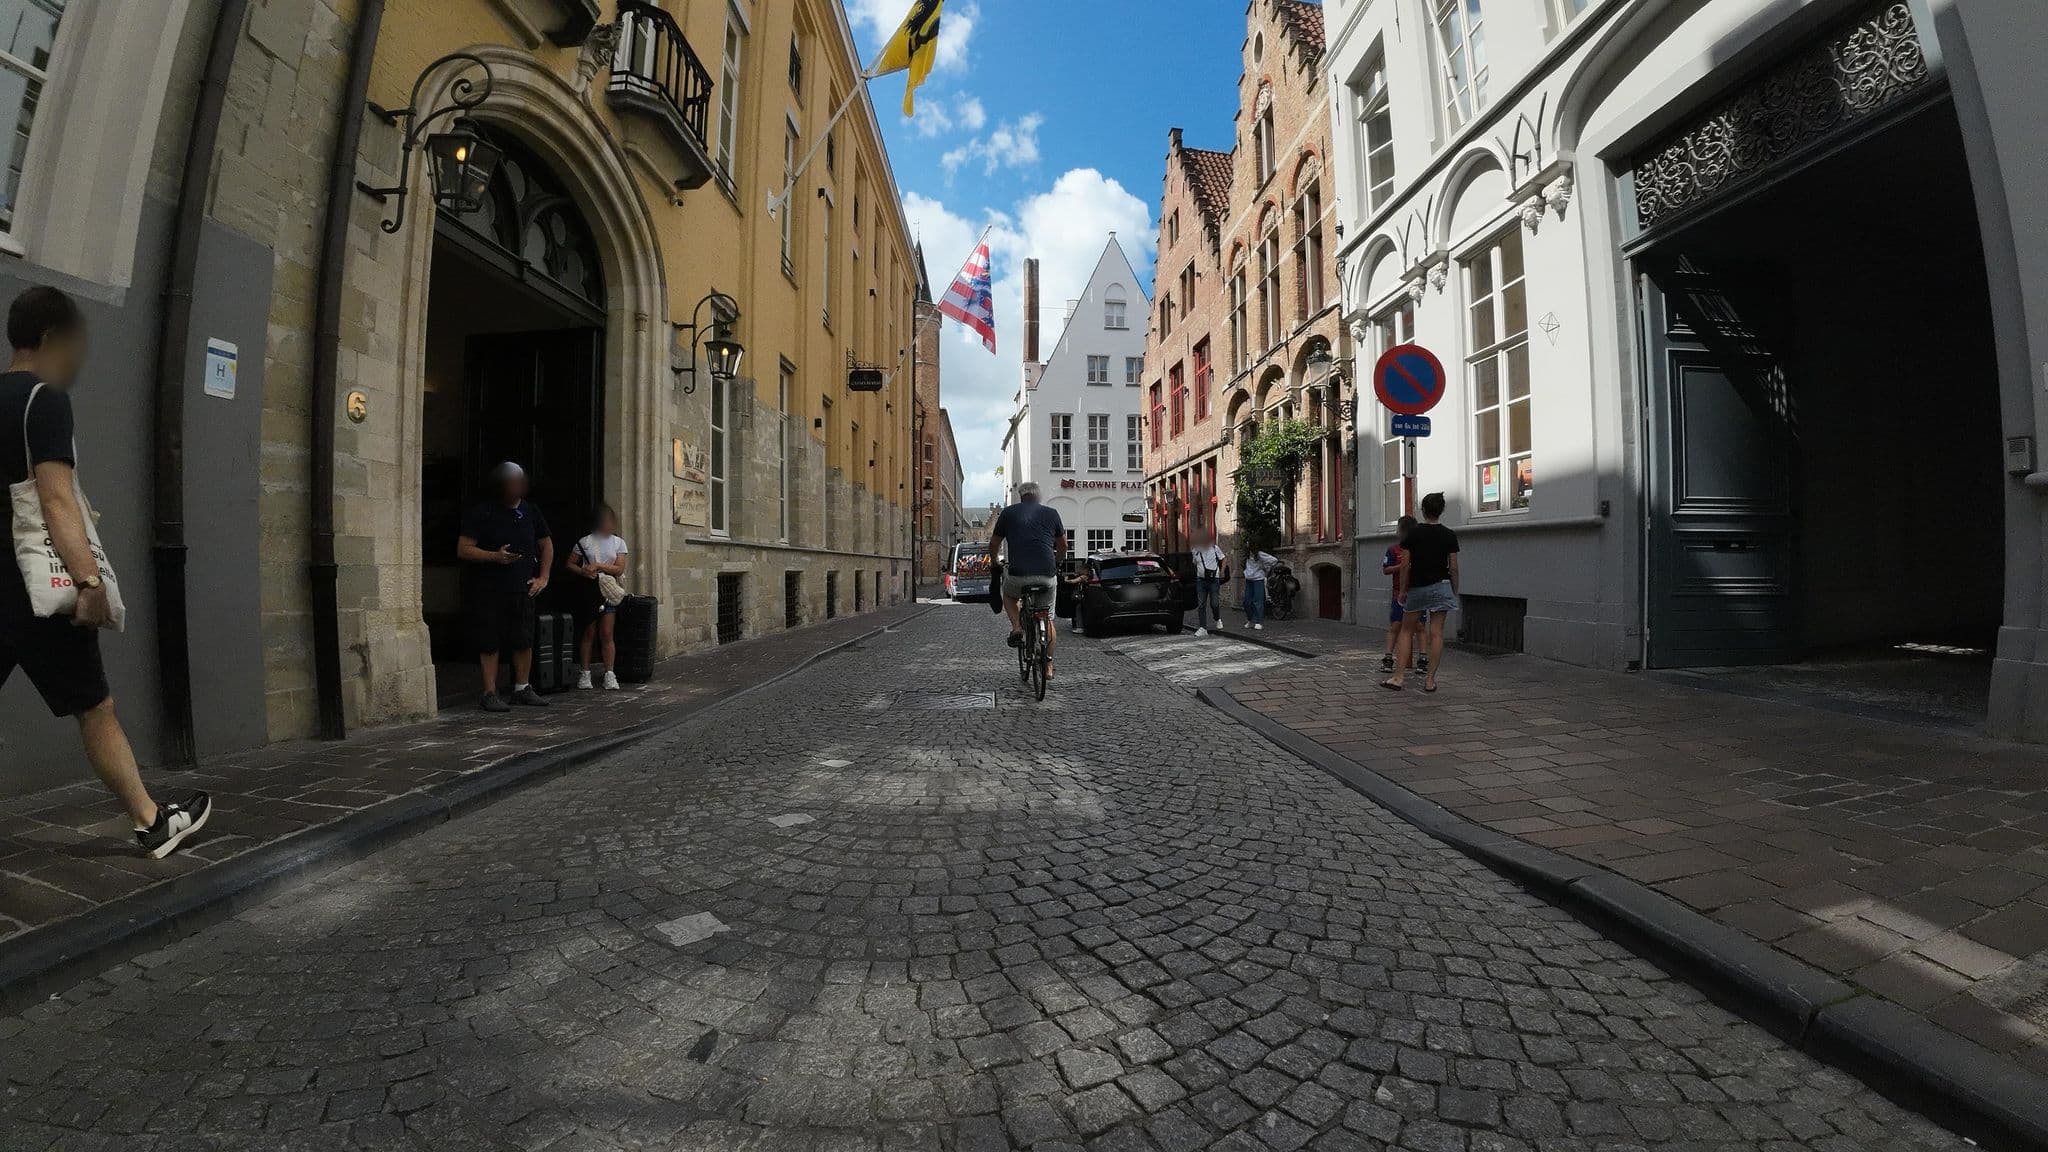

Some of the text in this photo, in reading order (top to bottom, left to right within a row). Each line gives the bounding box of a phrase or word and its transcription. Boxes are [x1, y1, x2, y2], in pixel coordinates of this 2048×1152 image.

[216, 362, 226, 378] H
[347, 390, 368, 424] 6
[1250, 469, 1286, 478] HOTEL
[1075, 481, 1145, 489] CROWNE PLAZ
